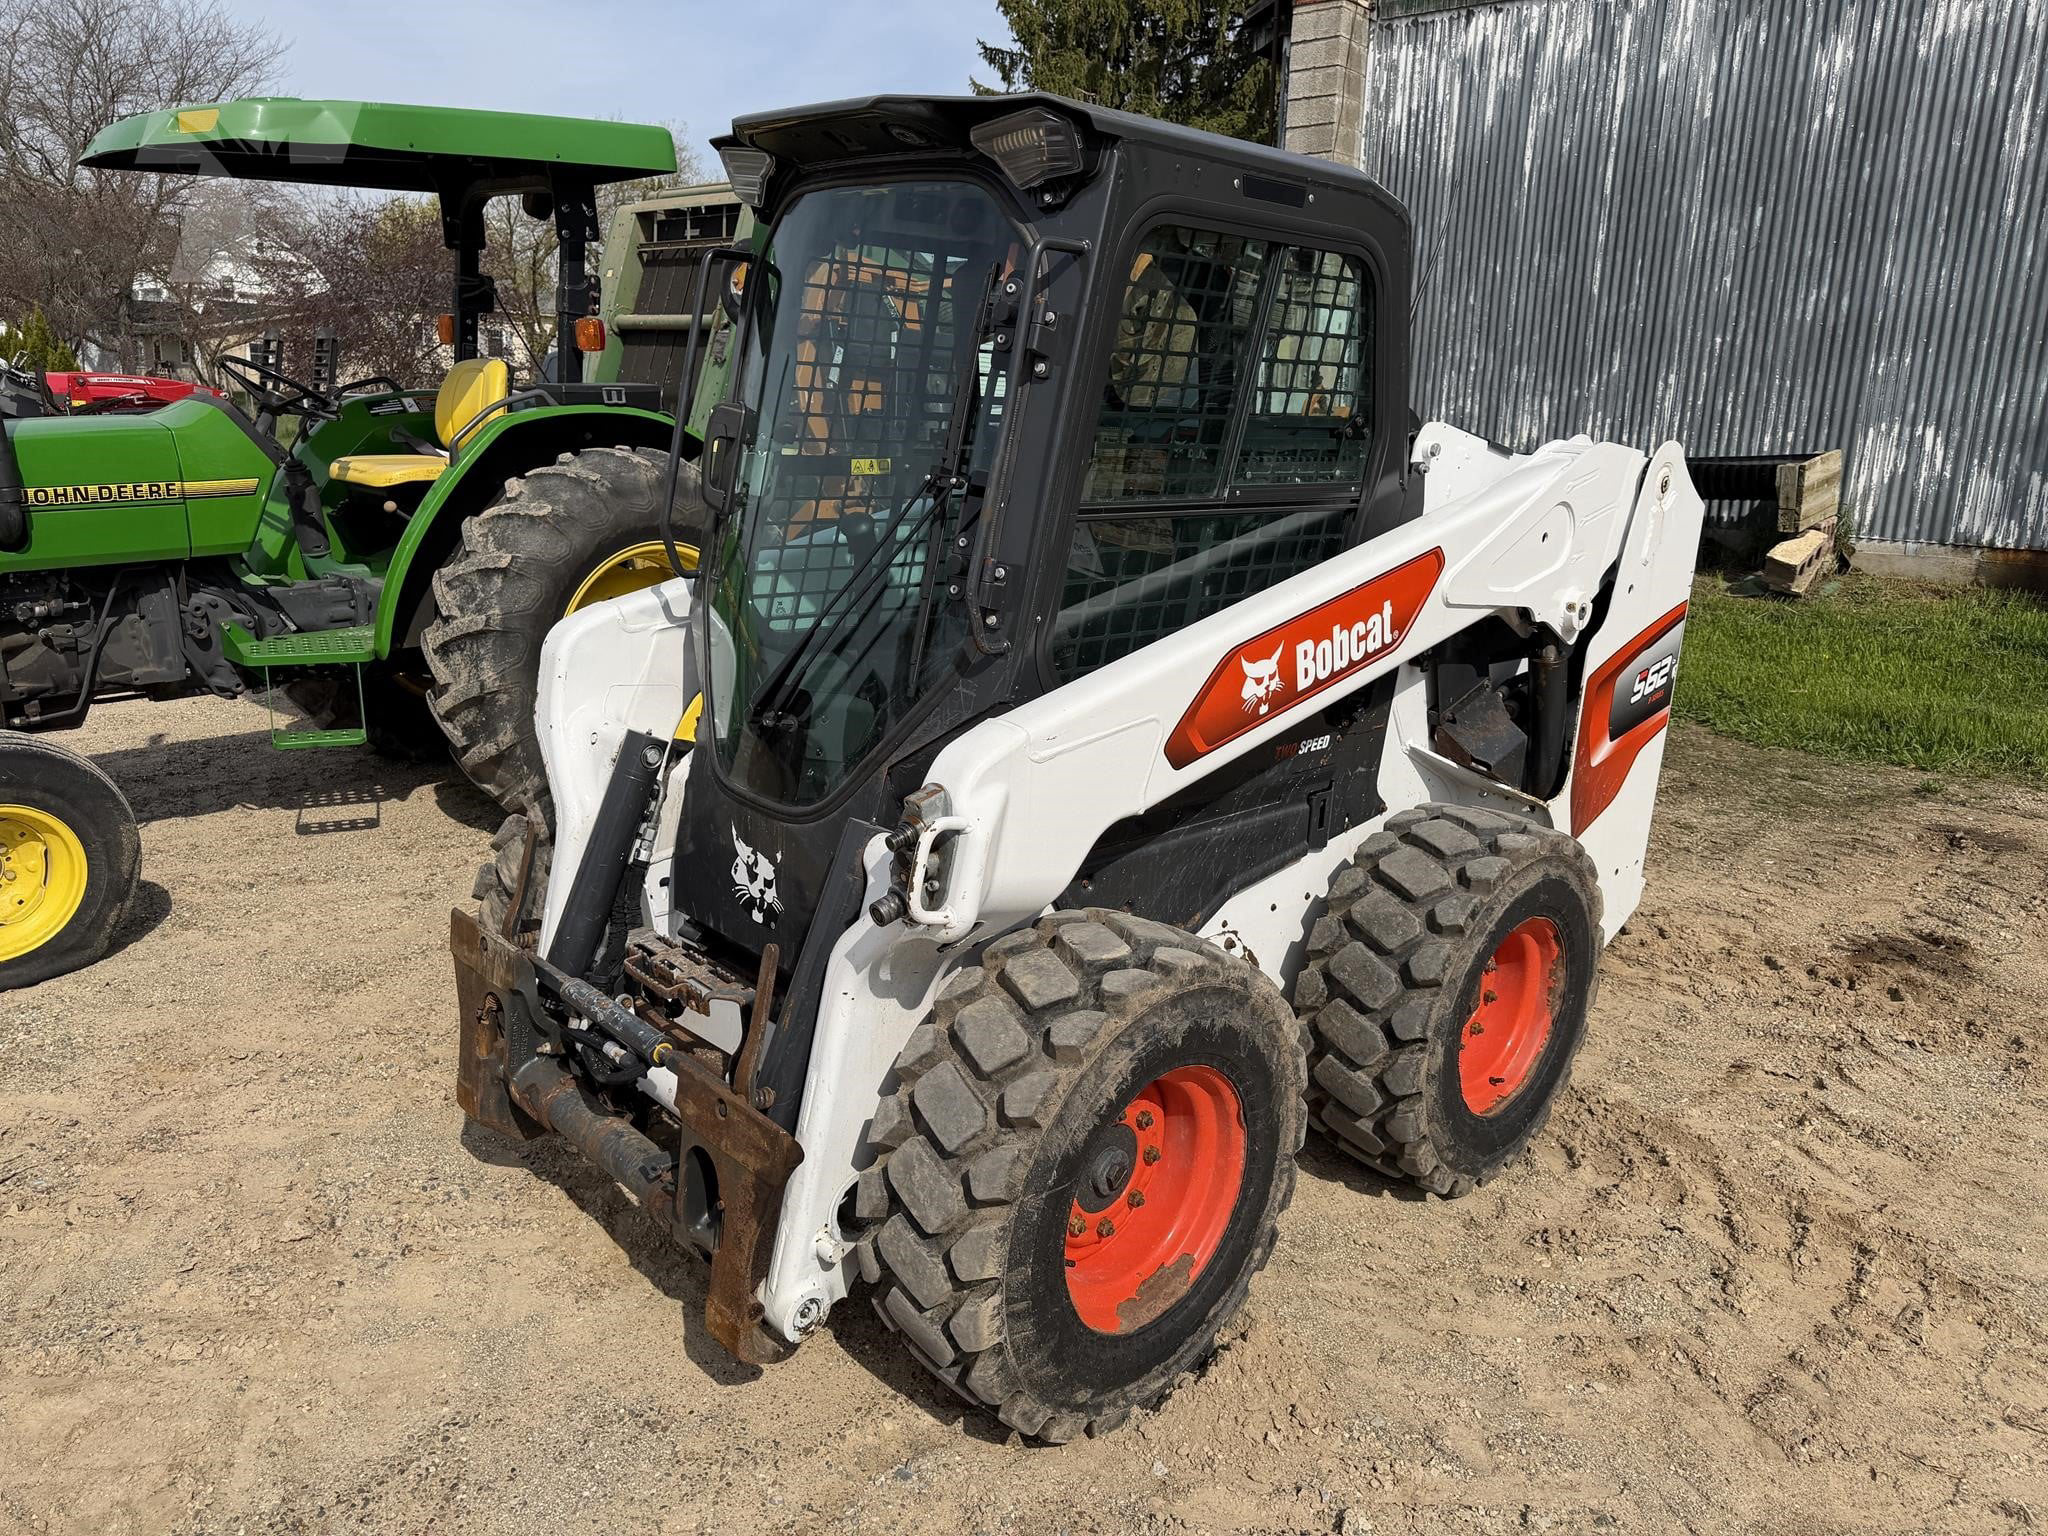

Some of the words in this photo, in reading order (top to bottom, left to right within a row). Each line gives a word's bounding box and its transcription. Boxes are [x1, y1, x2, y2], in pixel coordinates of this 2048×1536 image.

[21, 486, 89, 505] JOHN
[98, 482, 178, 502] DEERE
[1295, 599, 1393, 692] Bobcat
[1630, 655, 1673, 704] S62
[1298, 734, 1331, 755] SPEED
